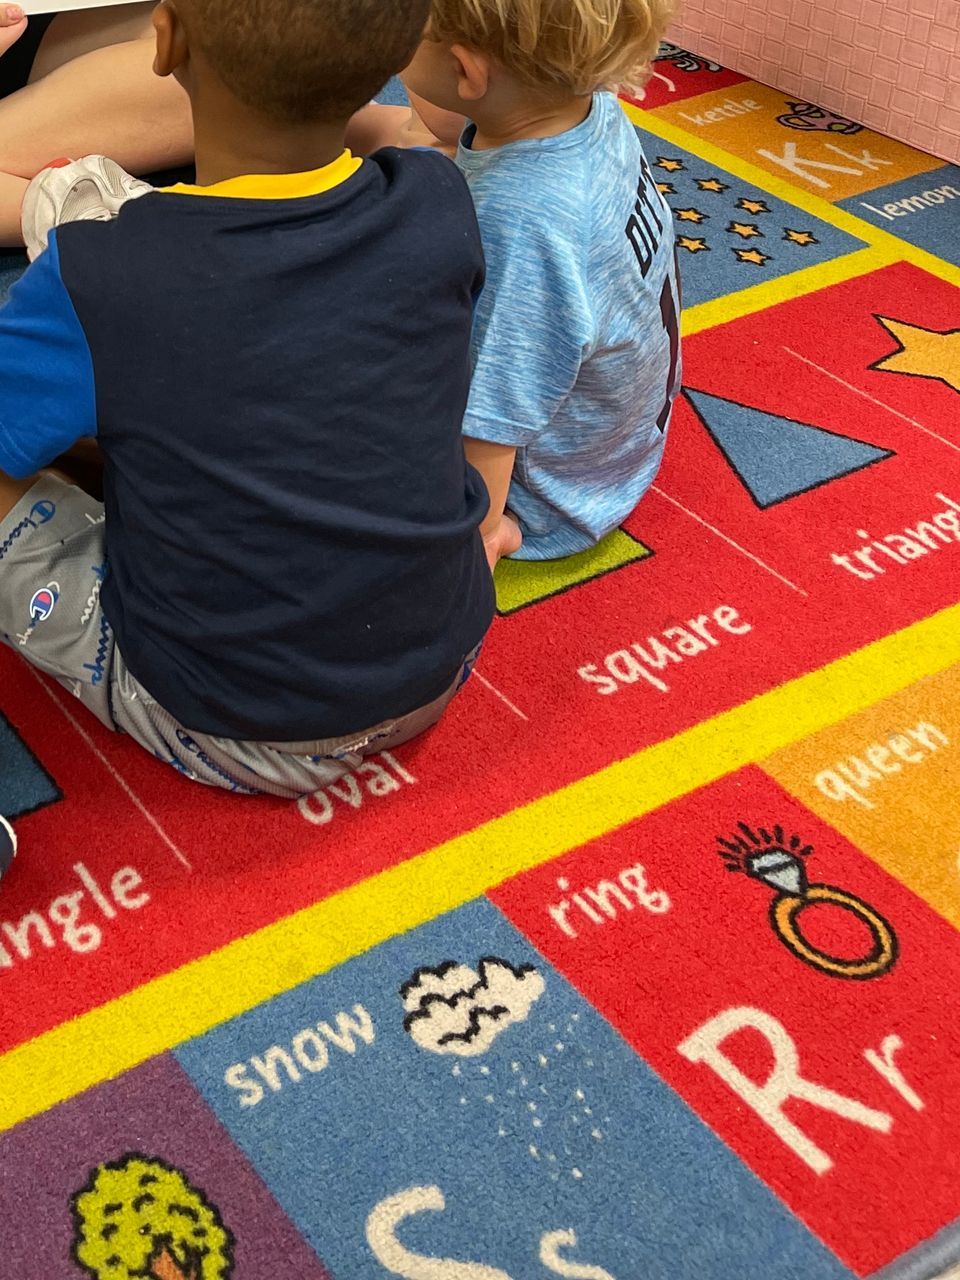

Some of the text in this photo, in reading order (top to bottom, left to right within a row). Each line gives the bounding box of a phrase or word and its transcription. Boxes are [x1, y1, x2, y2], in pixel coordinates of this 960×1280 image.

[679, 97, 763, 127] kettle
[860, 185, 960, 221] lemon
[830, 491, 960, 581] triang
[577, 602, 752, 695] square
[297, 750, 419, 826] oval
[813, 719, 949, 810] queen
[548, 861, 672, 939] ring
[224, 1004, 376, 1108] snow
